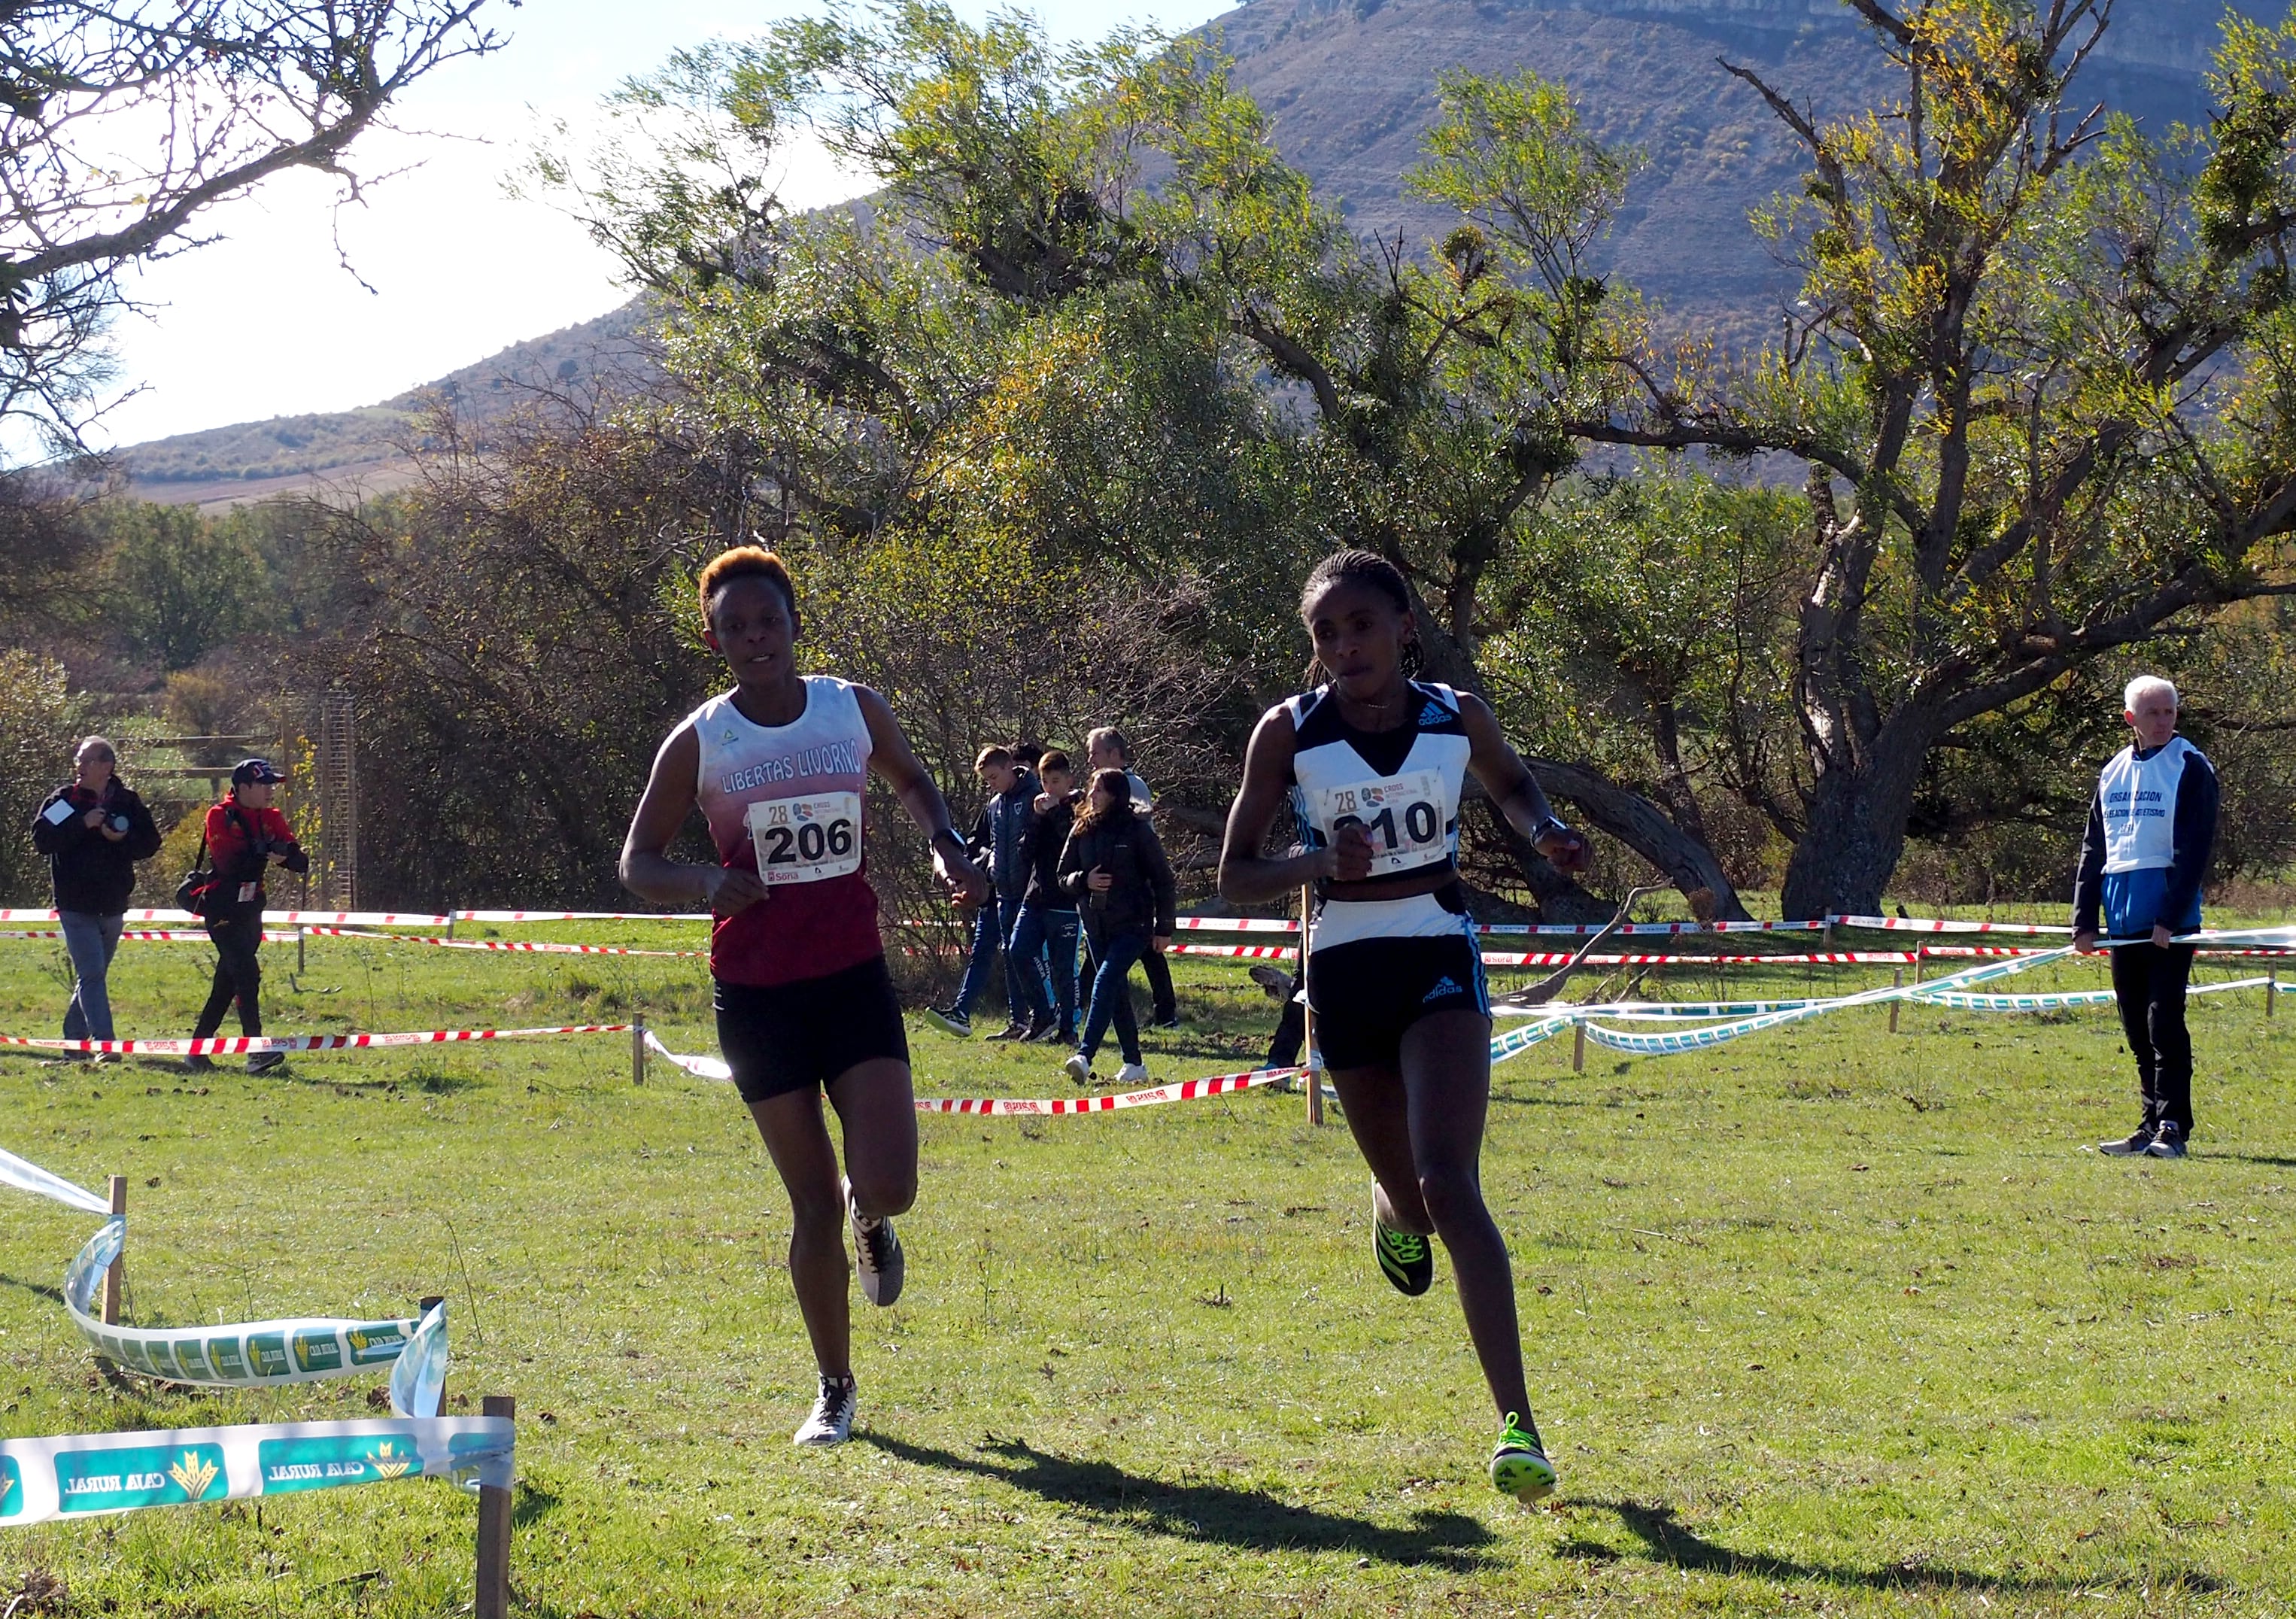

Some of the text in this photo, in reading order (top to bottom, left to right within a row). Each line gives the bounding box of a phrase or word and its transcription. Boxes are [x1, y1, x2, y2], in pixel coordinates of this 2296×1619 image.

[1419, 715, 1452, 725] adidas
[721, 739, 861, 793] LIBERTAS LIVORNO
[1335, 790, 1357, 813] 28
[769, 805, 788, 825] 28
[764, 819, 852, 864] 206
[1423, 985, 1463, 1004] adidas
